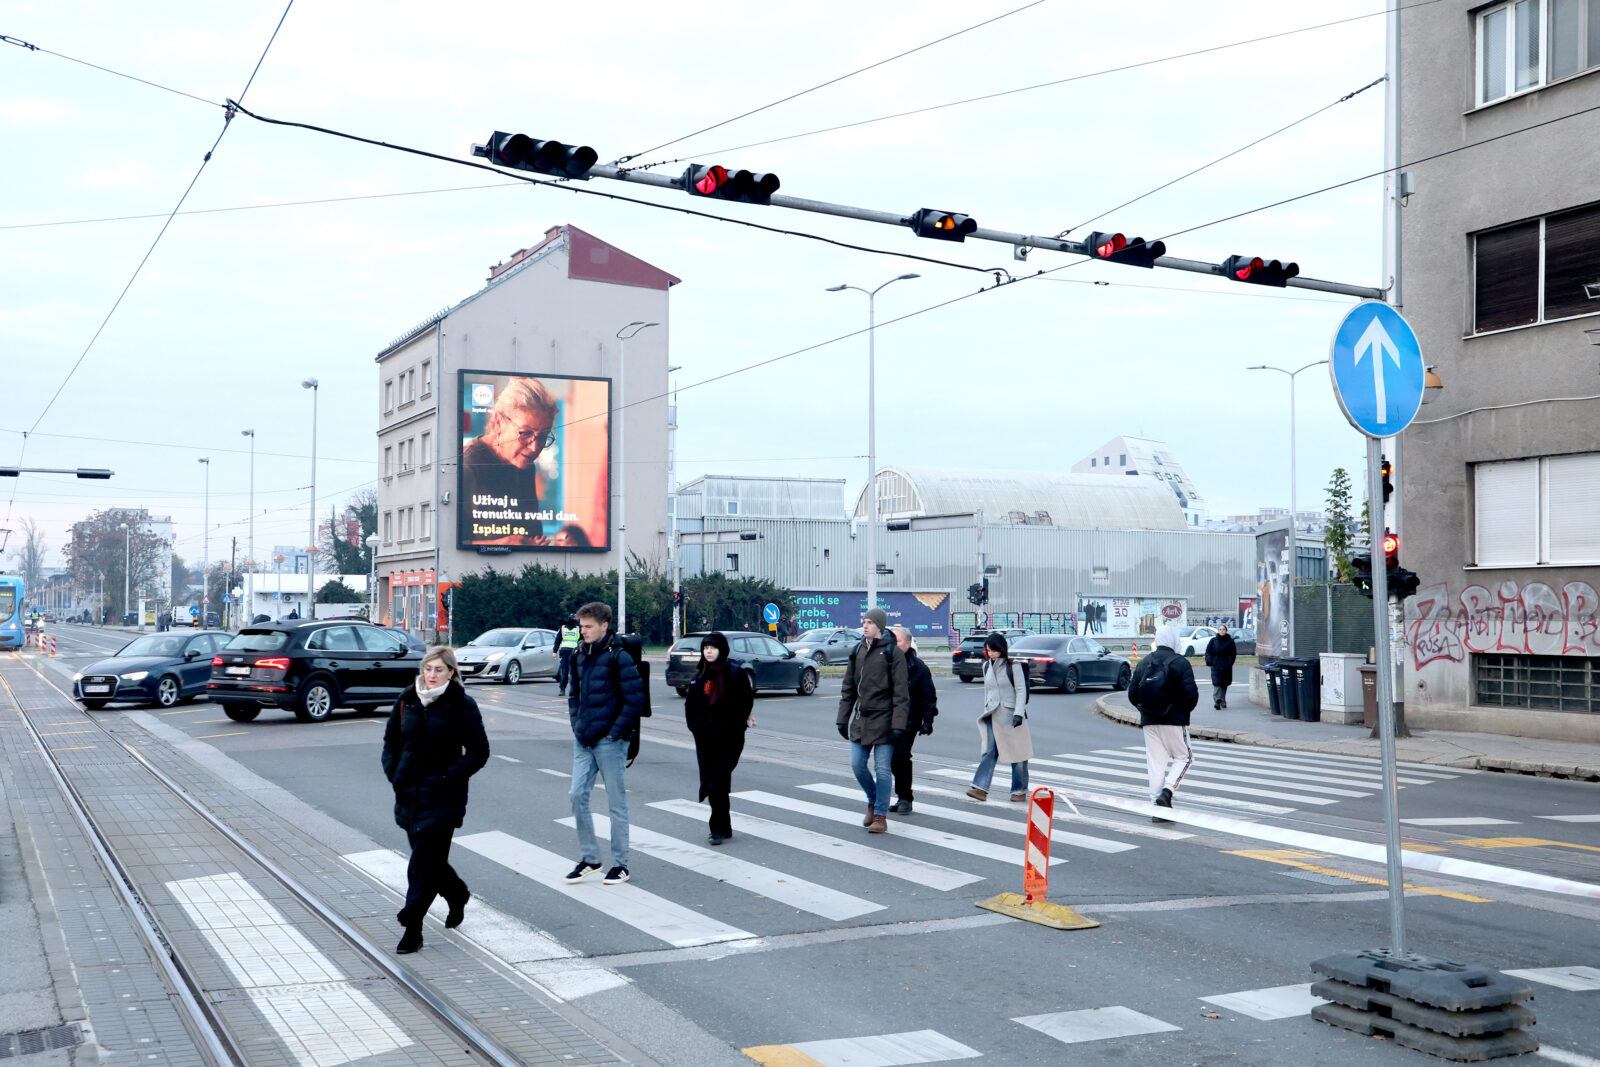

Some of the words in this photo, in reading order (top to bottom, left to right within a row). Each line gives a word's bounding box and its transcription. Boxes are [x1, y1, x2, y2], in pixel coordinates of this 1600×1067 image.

[473, 494, 508, 508] Uživaj
[510, 498, 518, 506] u
[472, 509, 522, 519] trenutku
[524, 510, 553, 520] svaki
[555, 511, 580, 521] dan.
[473, 523, 511, 536] Isplati
[512, 526, 529, 535] se.
[827, 597, 840, 605] se
[1114, 608, 1128, 617] 3.0
[797, 619, 819, 629] tebi
[821, 621, 834, 629] se
[1417, 636, 1458, 657] PUSA
